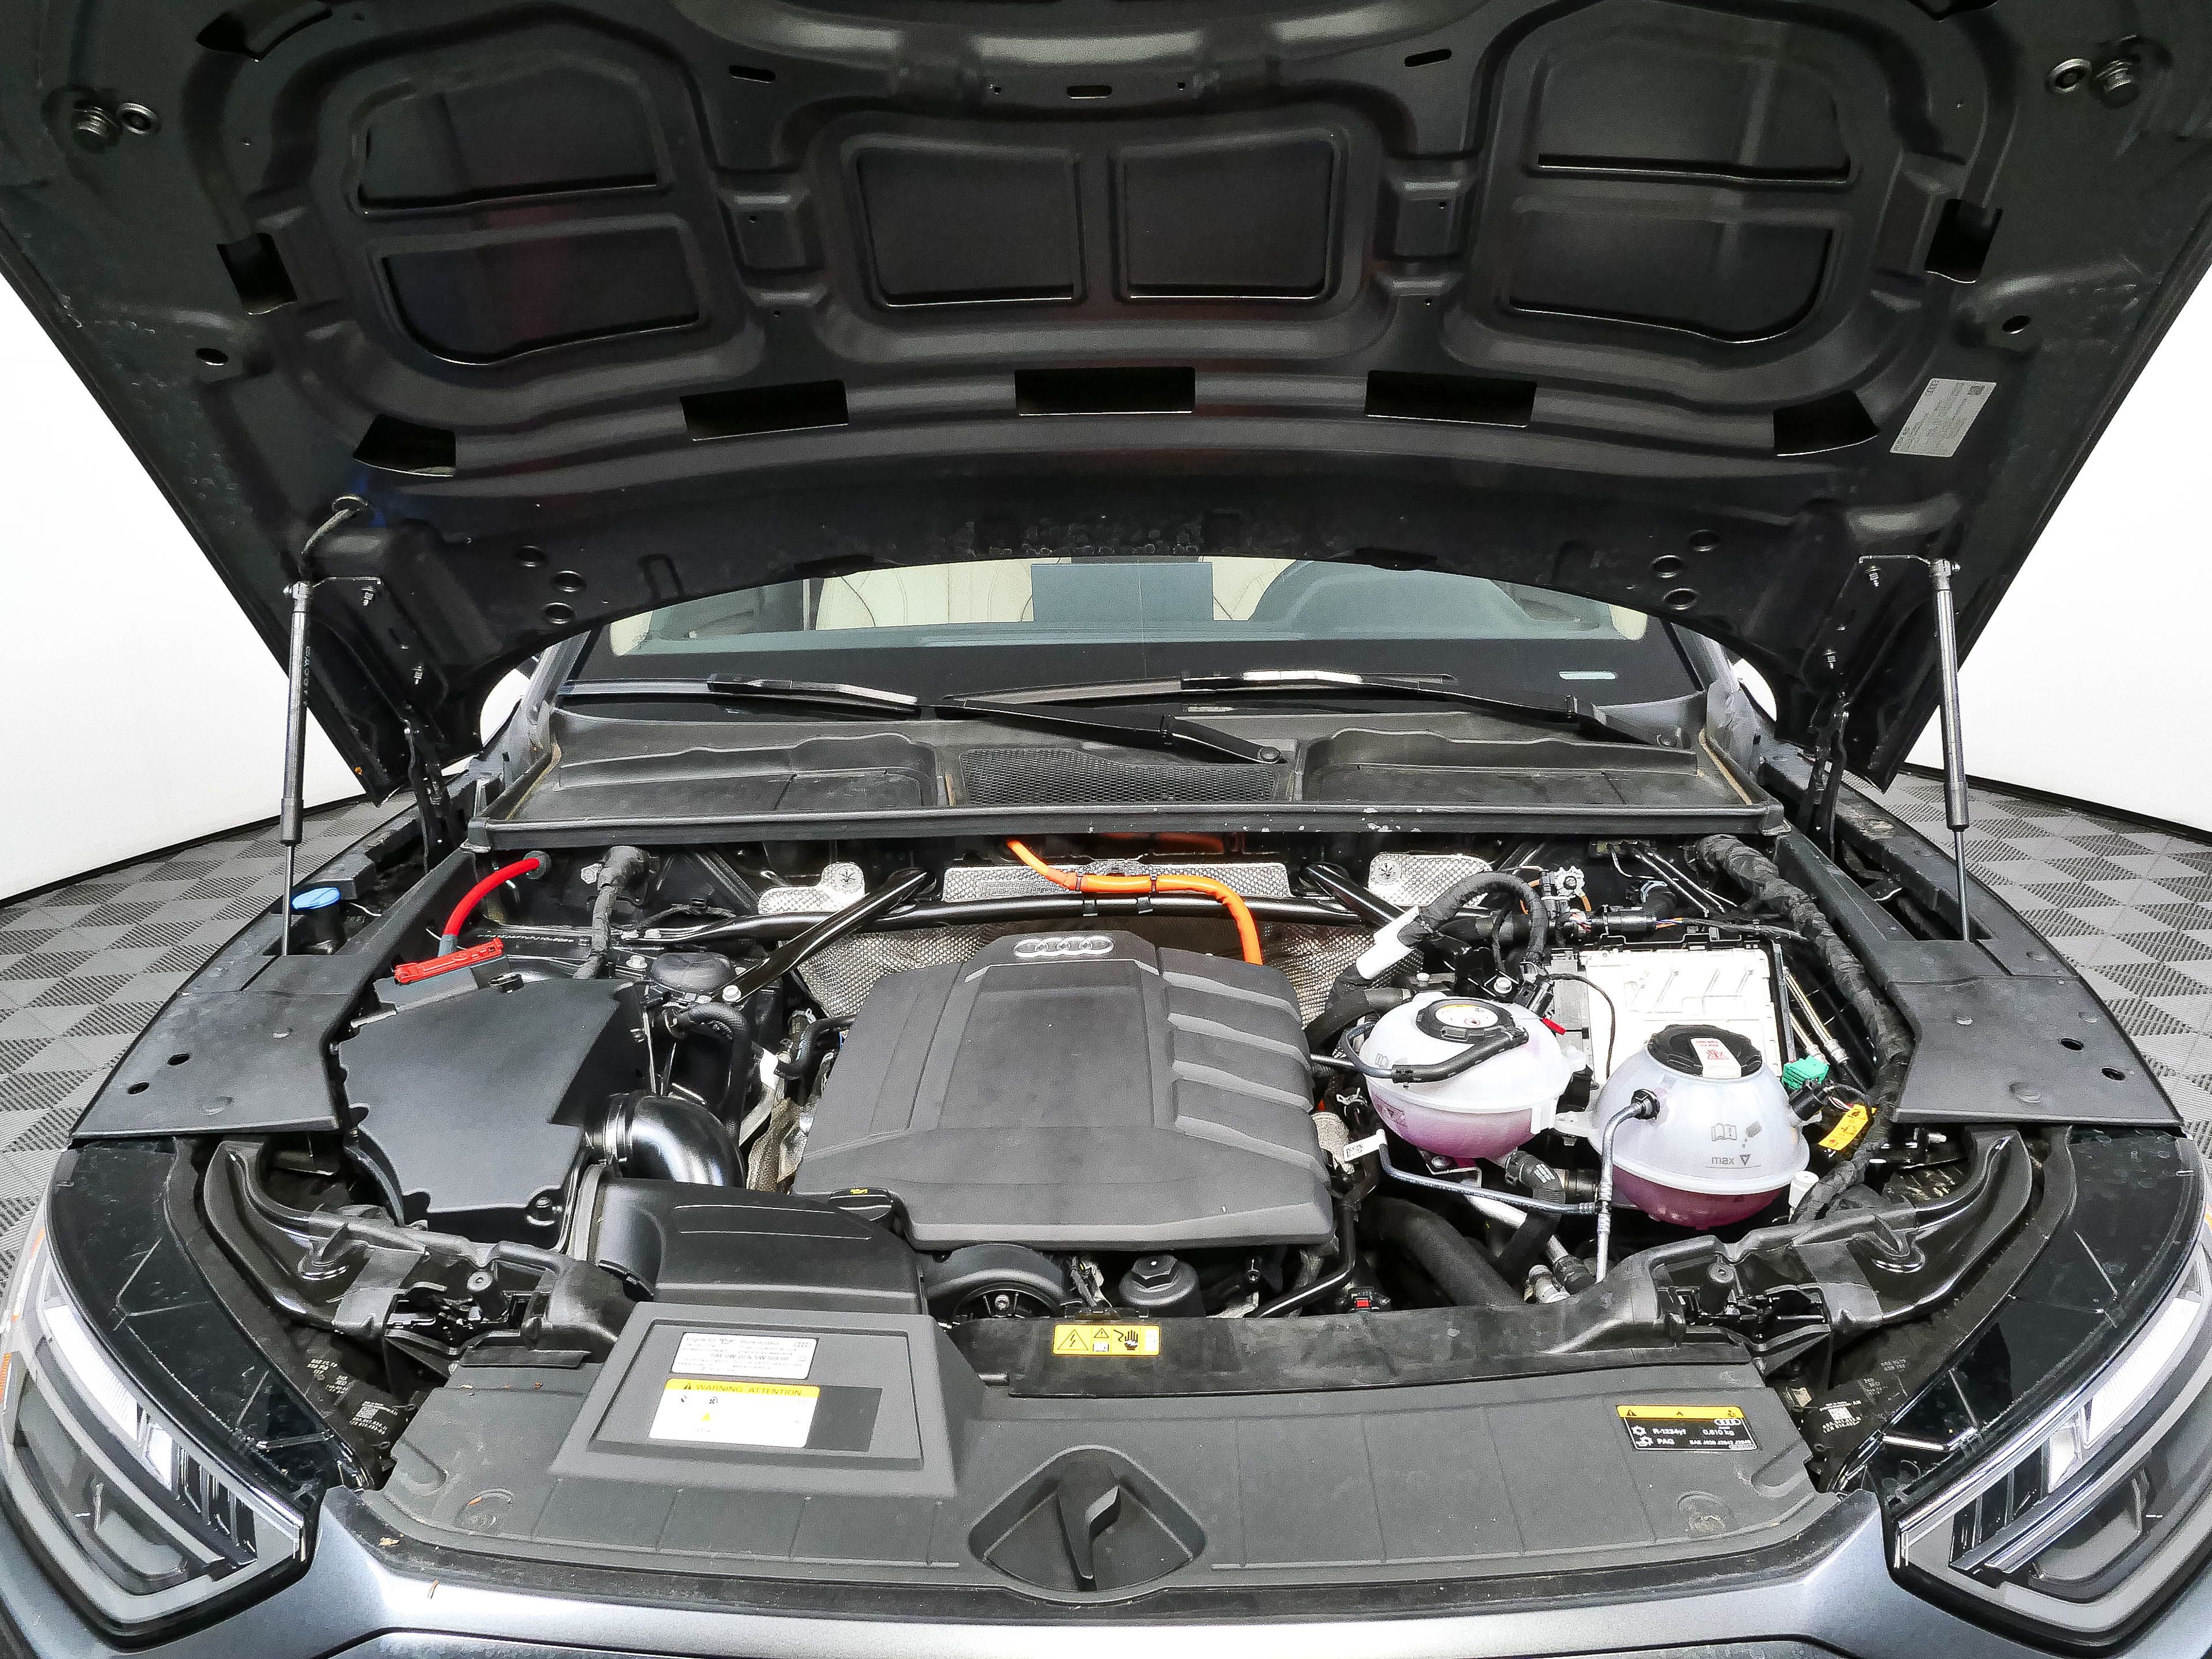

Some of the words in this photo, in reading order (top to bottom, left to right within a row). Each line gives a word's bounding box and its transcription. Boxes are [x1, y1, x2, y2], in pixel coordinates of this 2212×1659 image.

[1711, 1157, 1734, 1165] max
[696, 1384, 743, 1393] WARNING
[748, 1387, 802, 1396] ATTENTION
